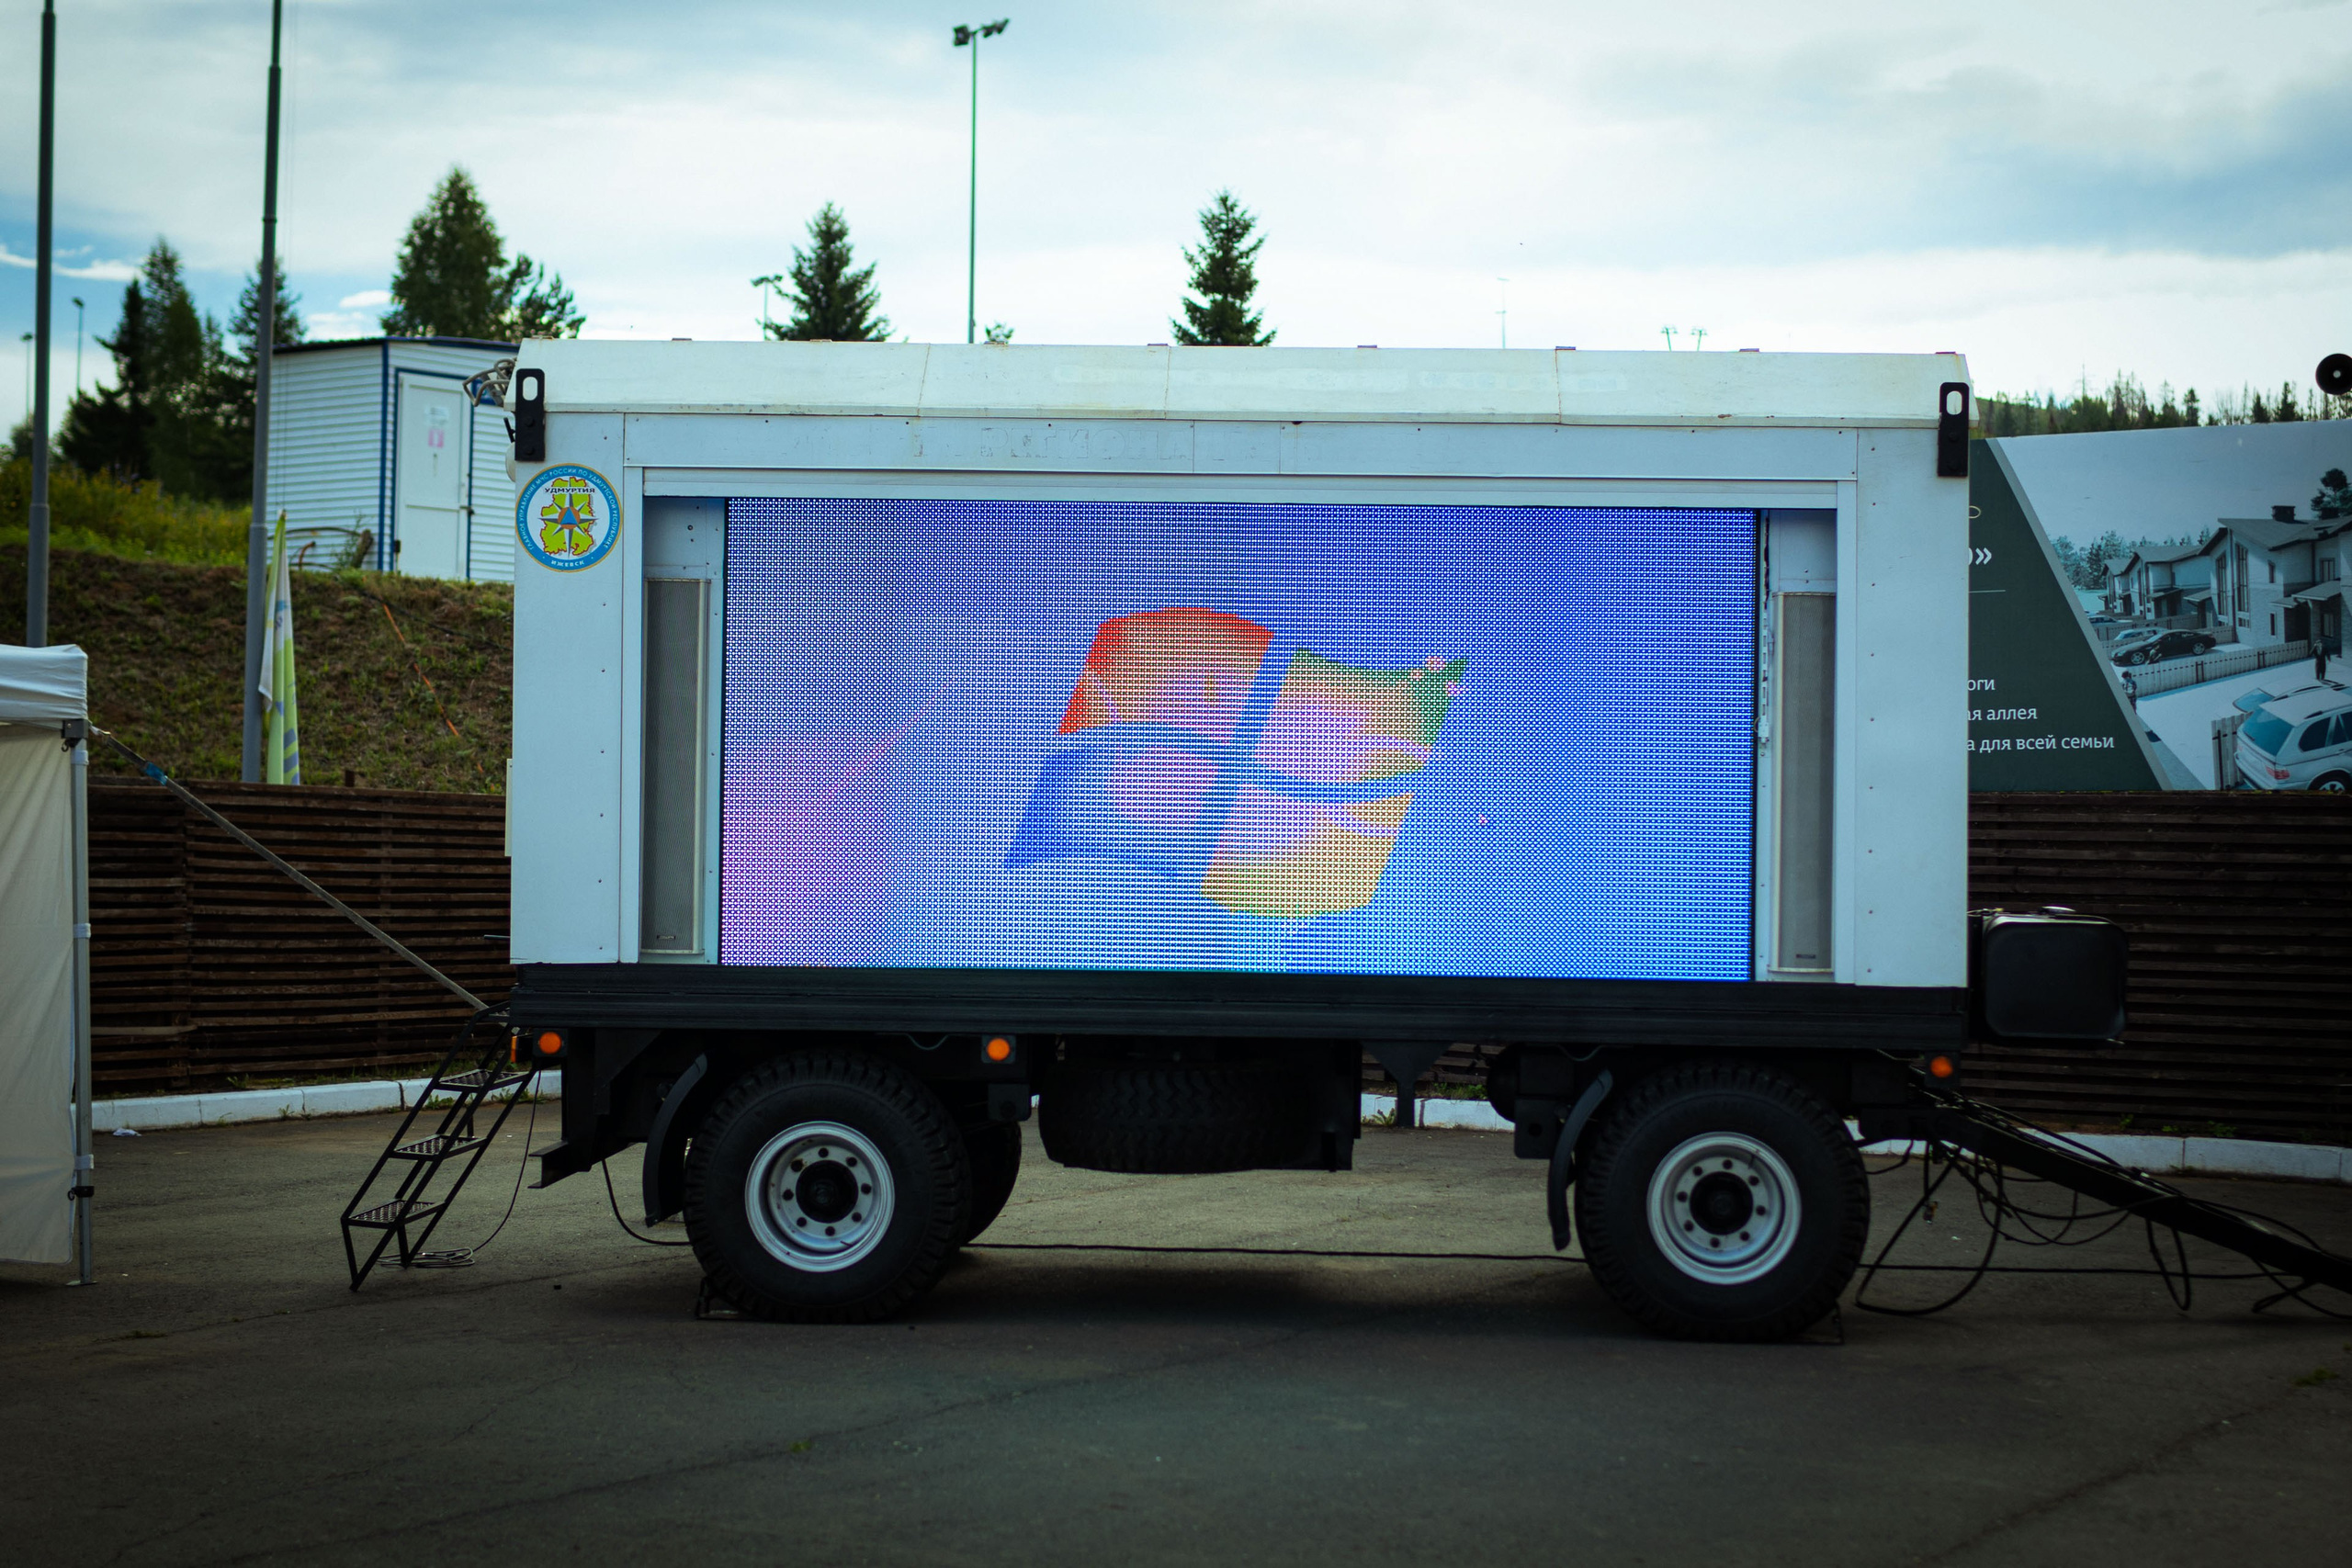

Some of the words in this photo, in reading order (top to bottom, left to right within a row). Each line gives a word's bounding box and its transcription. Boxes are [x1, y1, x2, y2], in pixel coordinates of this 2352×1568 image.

[536, 473, 549, 484] МЧС
[549, 468, 577, 478] РОССИИ
[577, 468, 588, 477] ПО
[588, 473, 616, 510] УДМУРТСКОЙ
[519, 484, 537, 522] УПРАВЛЕНИЕ
[519, 523, 534, 550] ГЛАВНОЕ
[604, 510, 618, 548] РЕСПУБЛИКЕ
[550, 559, 585, 568] ИЖЕВСК
[1986, 707, 2038, 720] аллея
[1979, 739, 2012, 753] для
[2016, 735, 2057, 750] всей
[2061, 736, 2115, 749] семьи
